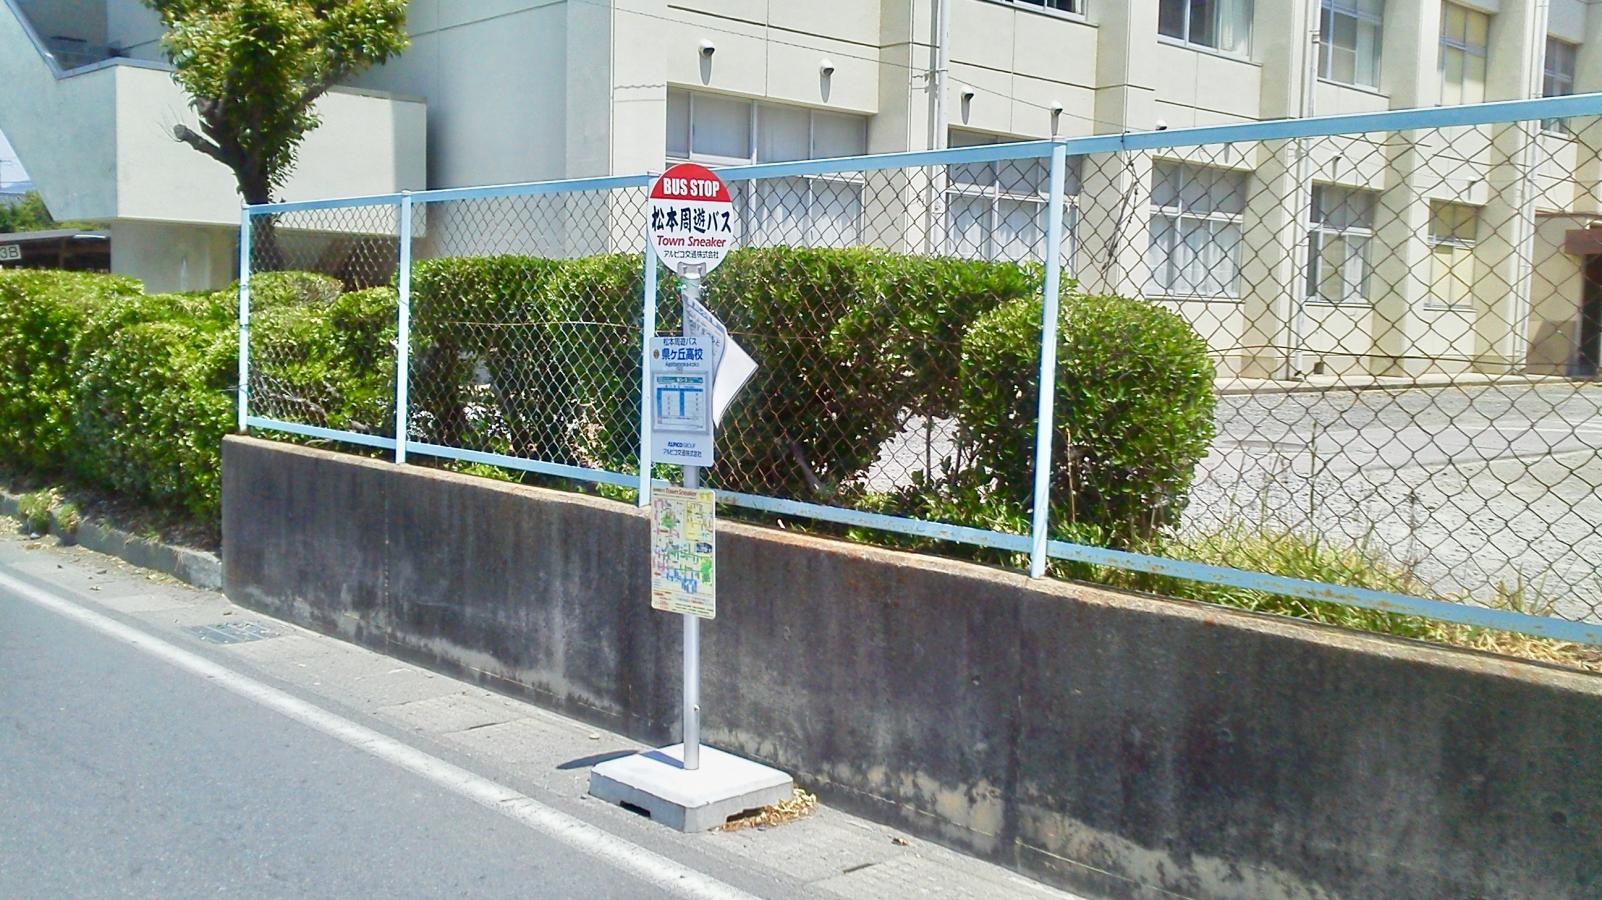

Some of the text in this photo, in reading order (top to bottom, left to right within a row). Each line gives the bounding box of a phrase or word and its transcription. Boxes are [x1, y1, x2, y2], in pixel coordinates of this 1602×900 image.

[663, 177, 720, 197] BUS STOP
[651, 205, 732, 234] 松本周遊バス
[657, 235, 727, 248] Town Sneaker
[663, 250, 720, 259] アルピコ交通株式会社
[663, 337, 698, 346] 松本周遊バス
